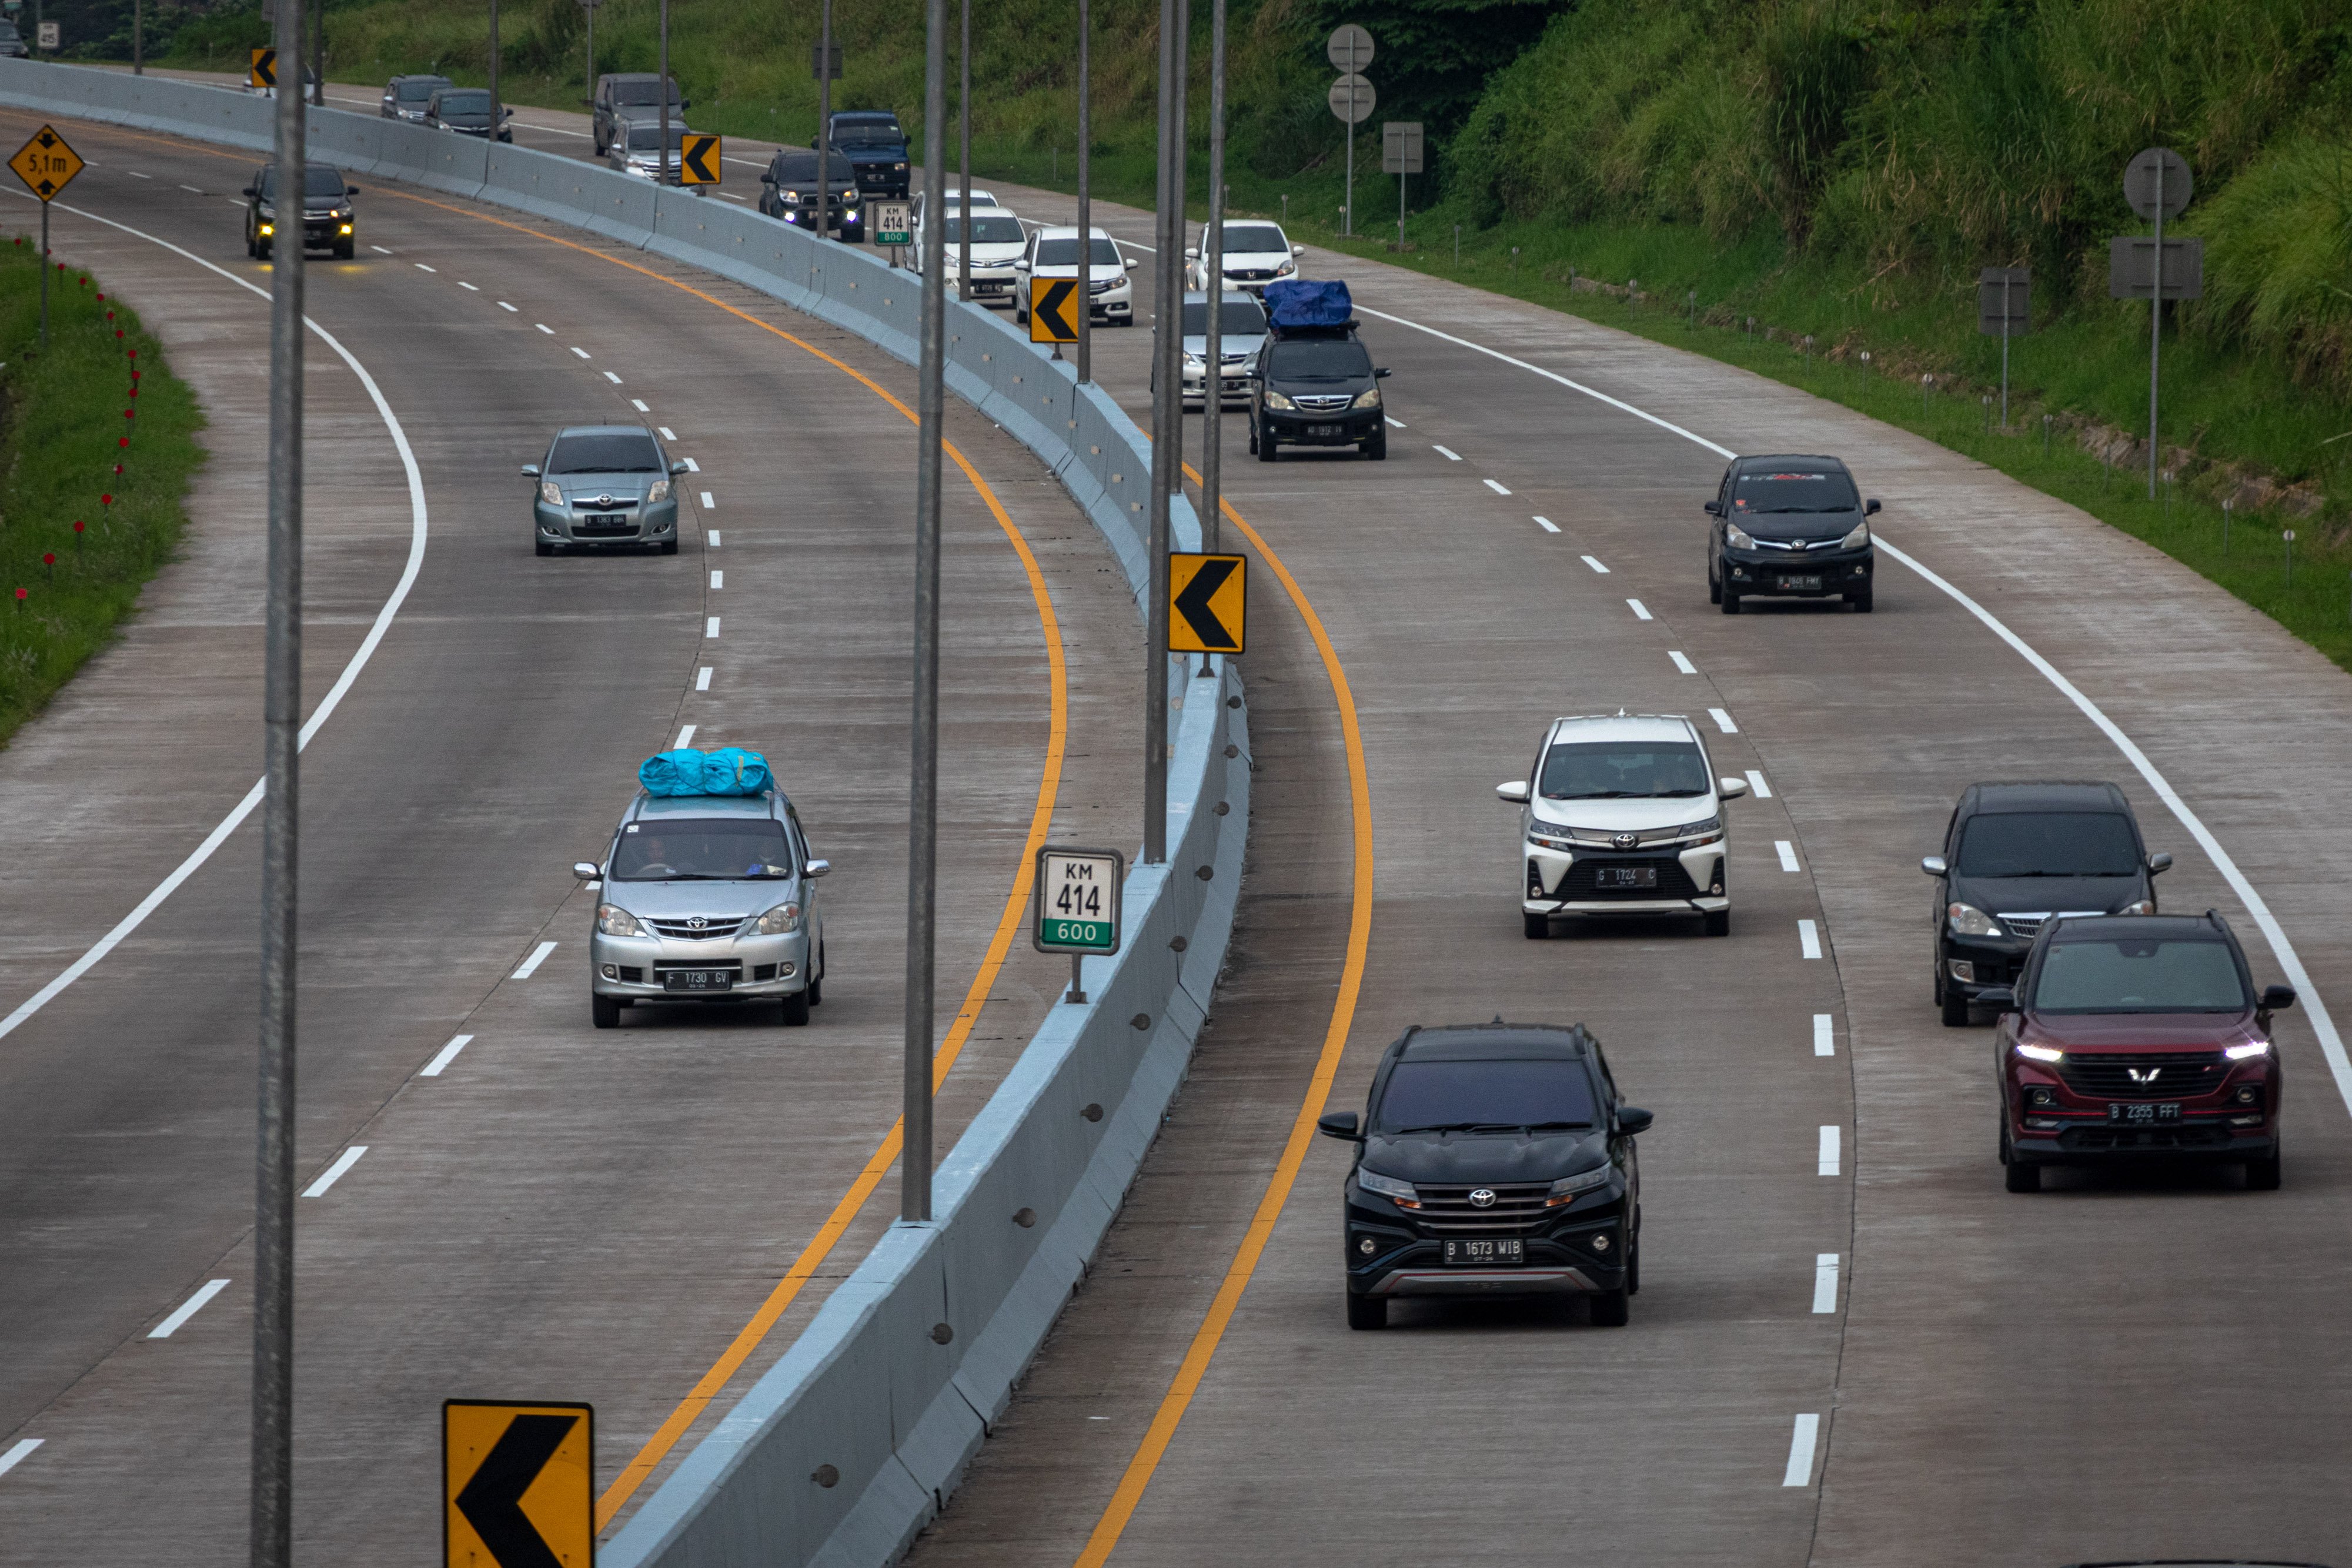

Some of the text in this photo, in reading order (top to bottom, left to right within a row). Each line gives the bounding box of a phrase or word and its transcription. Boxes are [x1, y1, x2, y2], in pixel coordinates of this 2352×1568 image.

[883, 216, 903, 230] 414
[1065, 862, 1093, 880] KM
[1599, 869, 1654, 881] G 1724 C
[1057, 883, 1100, 917] 414
[1057, 922, 1097, 941] 600
[686, 972, 707, 983] 1730
[716, 972, 727, 982] GV
[2112, 1104, 2180, 1119] B 2355 FFT
[1448, 1241, 1521, 1255] B 1673 WIB
